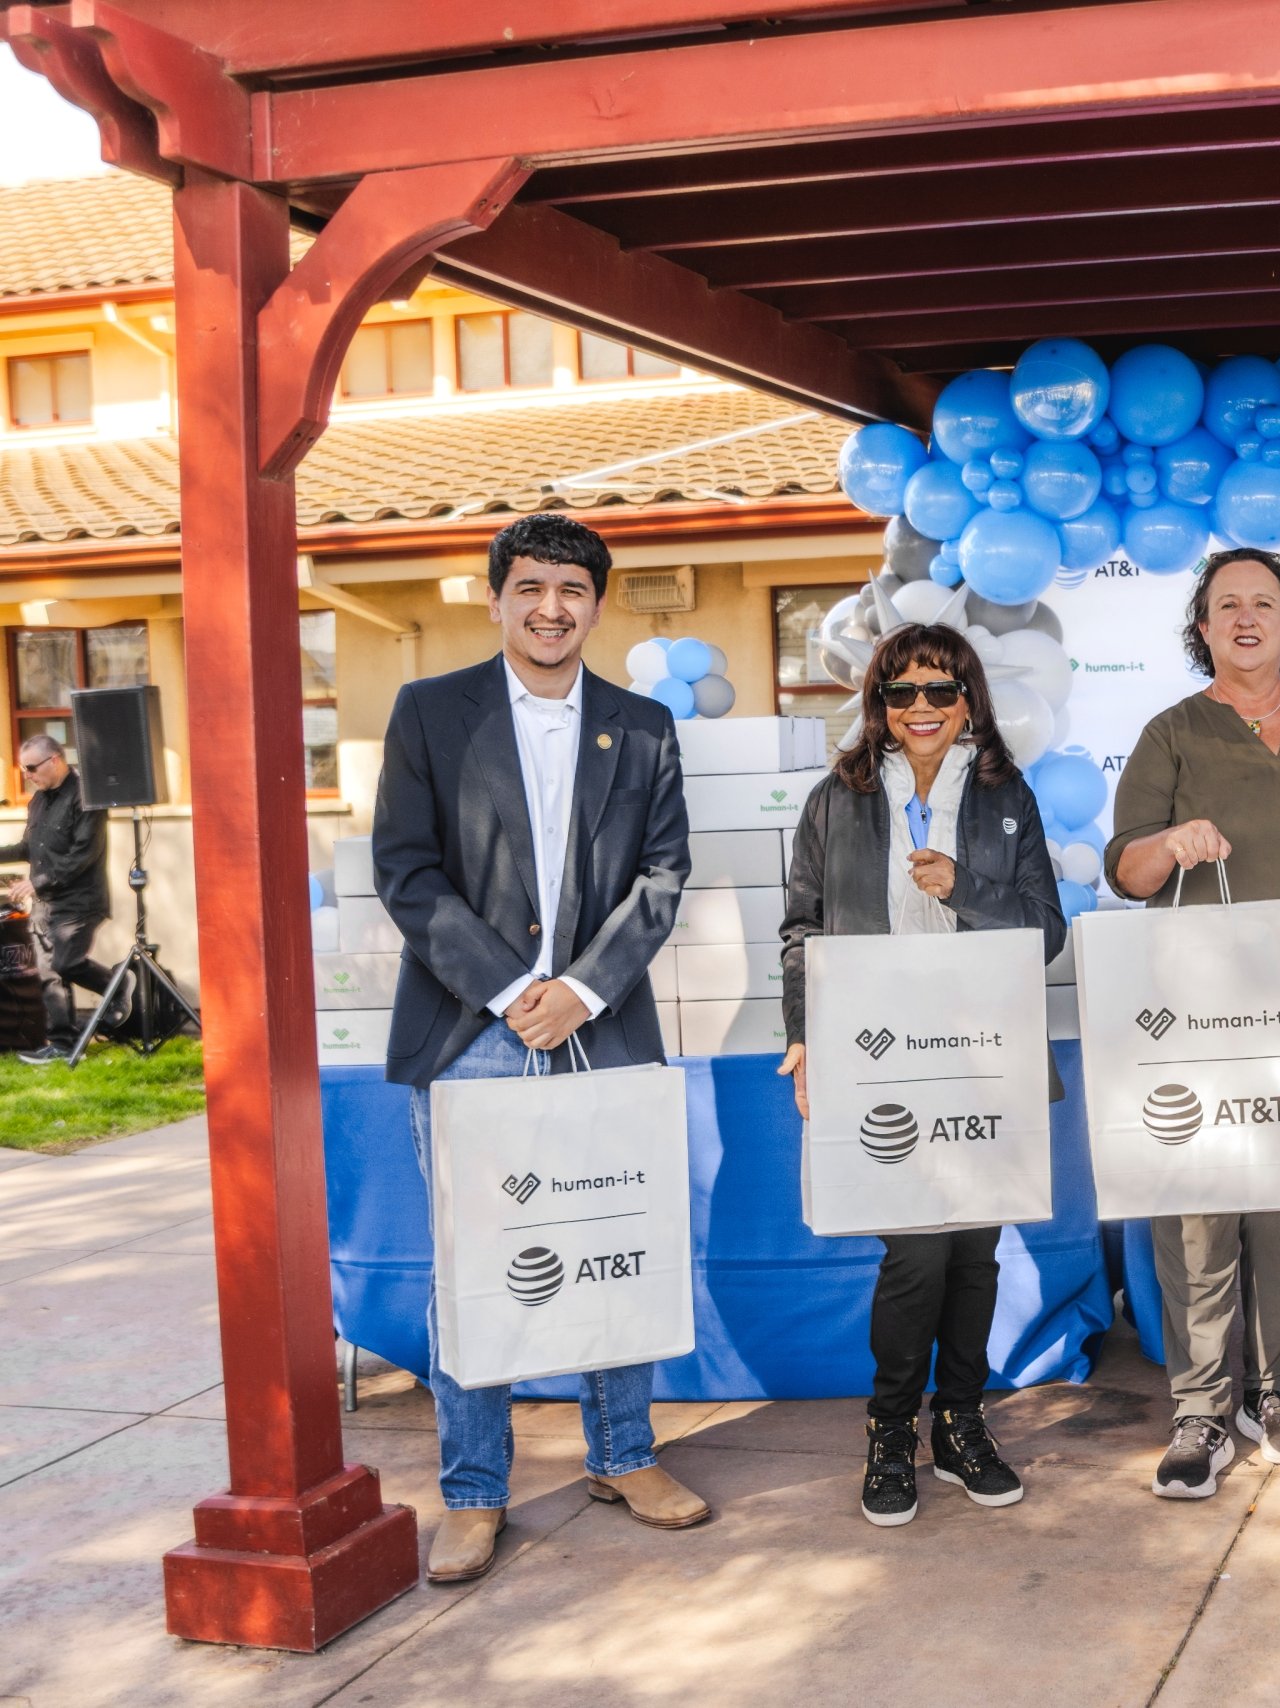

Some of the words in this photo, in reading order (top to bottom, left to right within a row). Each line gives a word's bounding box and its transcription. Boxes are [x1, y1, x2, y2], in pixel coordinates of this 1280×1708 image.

[1085, 661, 1145, 673] human-i-t
[760, 803, 799, 813] human-i-t
[907, 1032, 1003, 1050] human-i-t
[929, 1115, 1003, 1143] AT&T
[552, 1170, 646, 1193] human-i-t
[575, 1250, 646, 1283] AT&T
